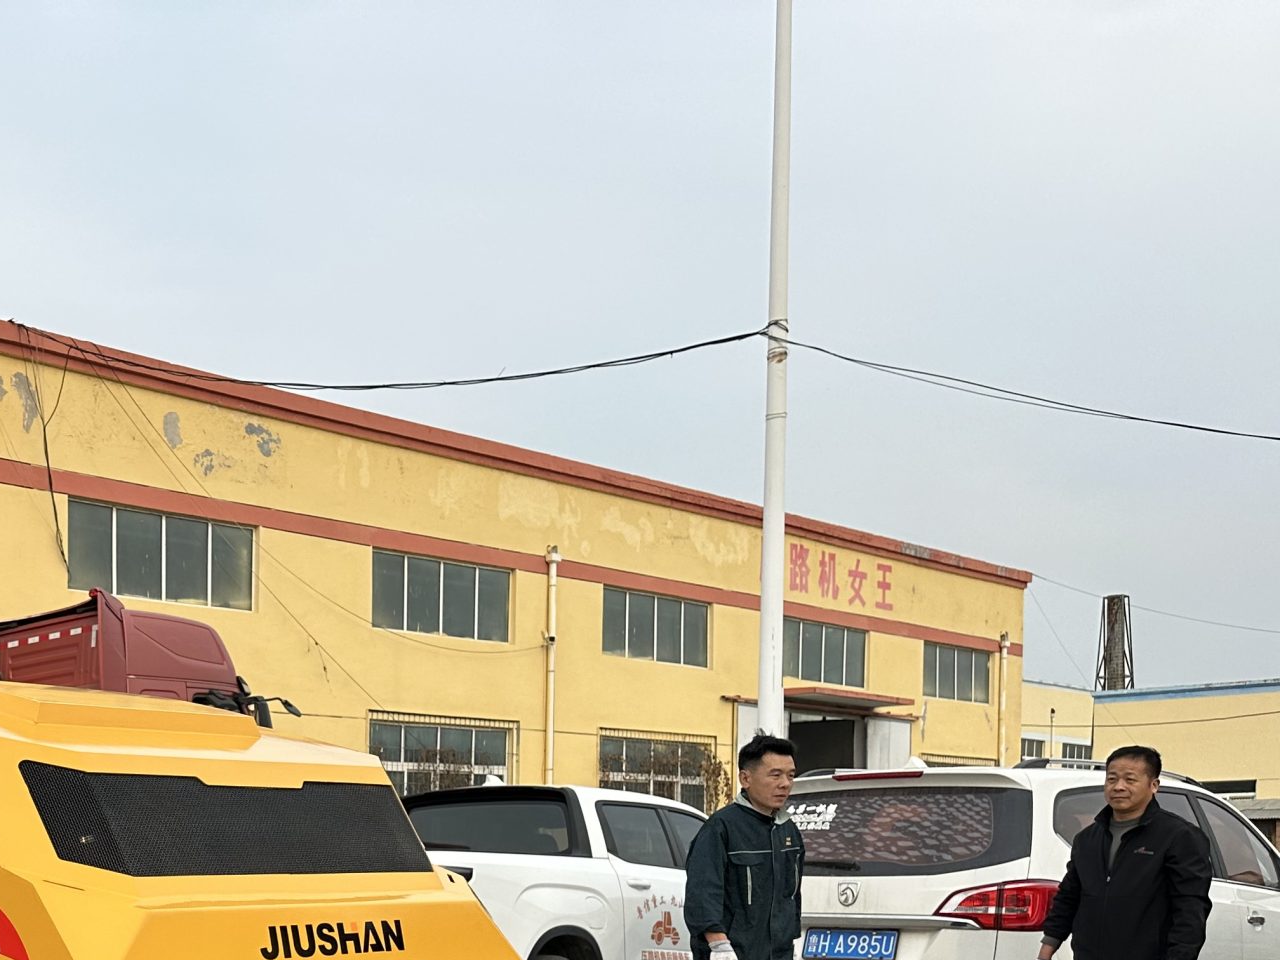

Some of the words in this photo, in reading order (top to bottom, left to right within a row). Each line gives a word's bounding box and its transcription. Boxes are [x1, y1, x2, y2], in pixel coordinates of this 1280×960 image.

[789, 543, 894, 611] 路机女王
[260, 919, 405, 960] JIUSHAN
